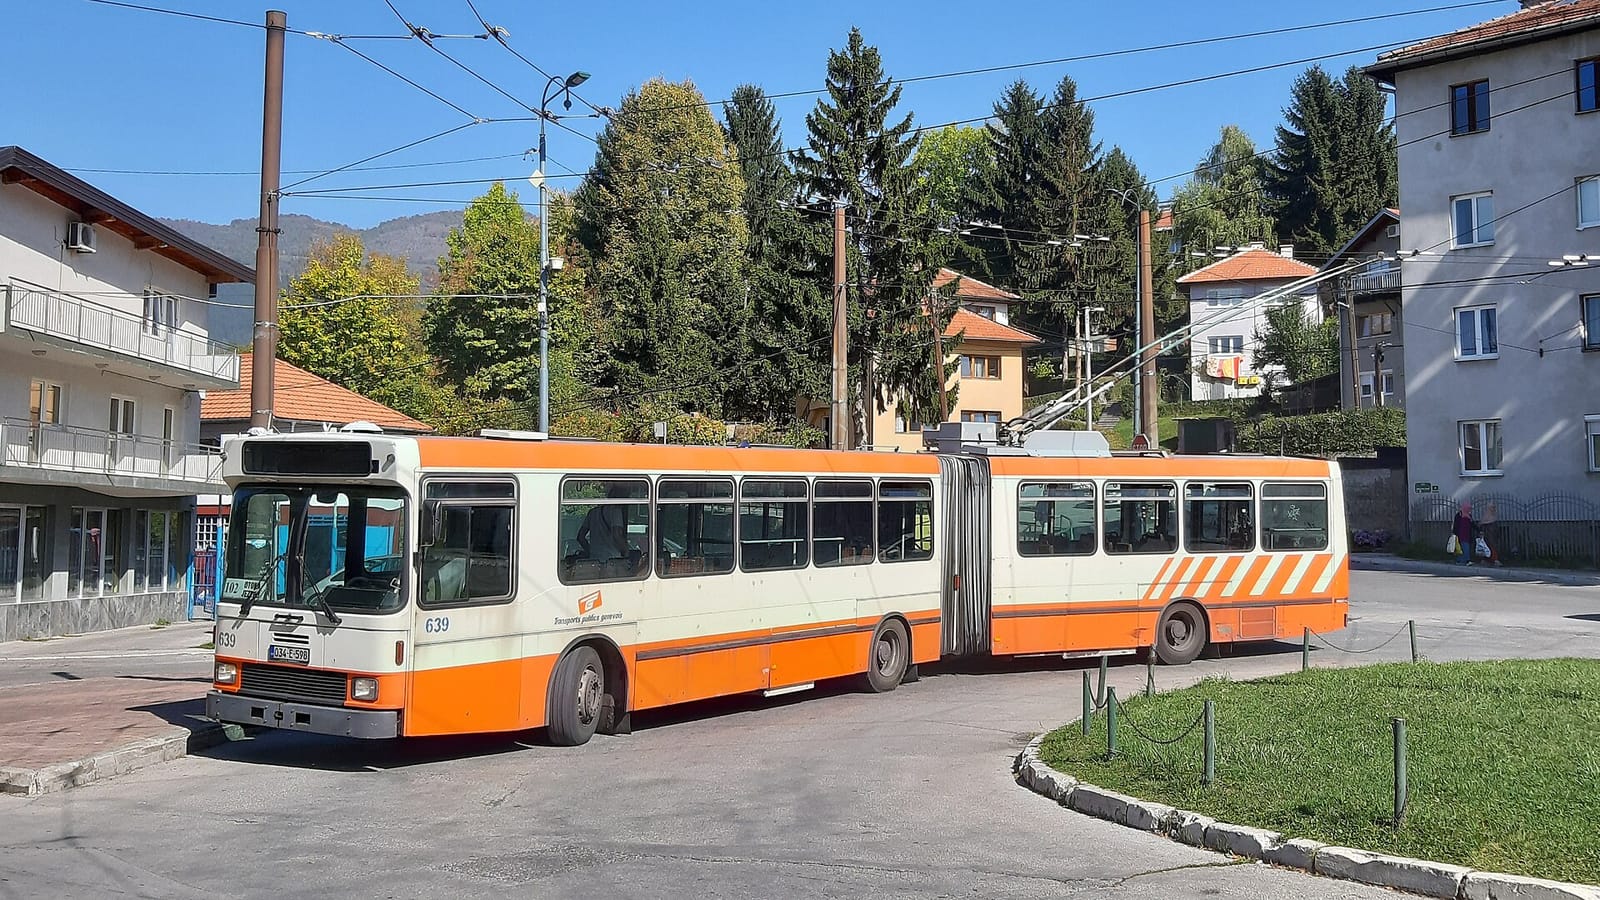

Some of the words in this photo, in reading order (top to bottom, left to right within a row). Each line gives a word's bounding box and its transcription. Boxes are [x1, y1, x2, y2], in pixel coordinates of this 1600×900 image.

[225, 582, 239, 594] 102
[426, 616, 450, 633] 639
[554, 614, 581, 626] Transports
[218, 632, 237, 648] 639
[274, 647, 308, 660] 034-E-598
